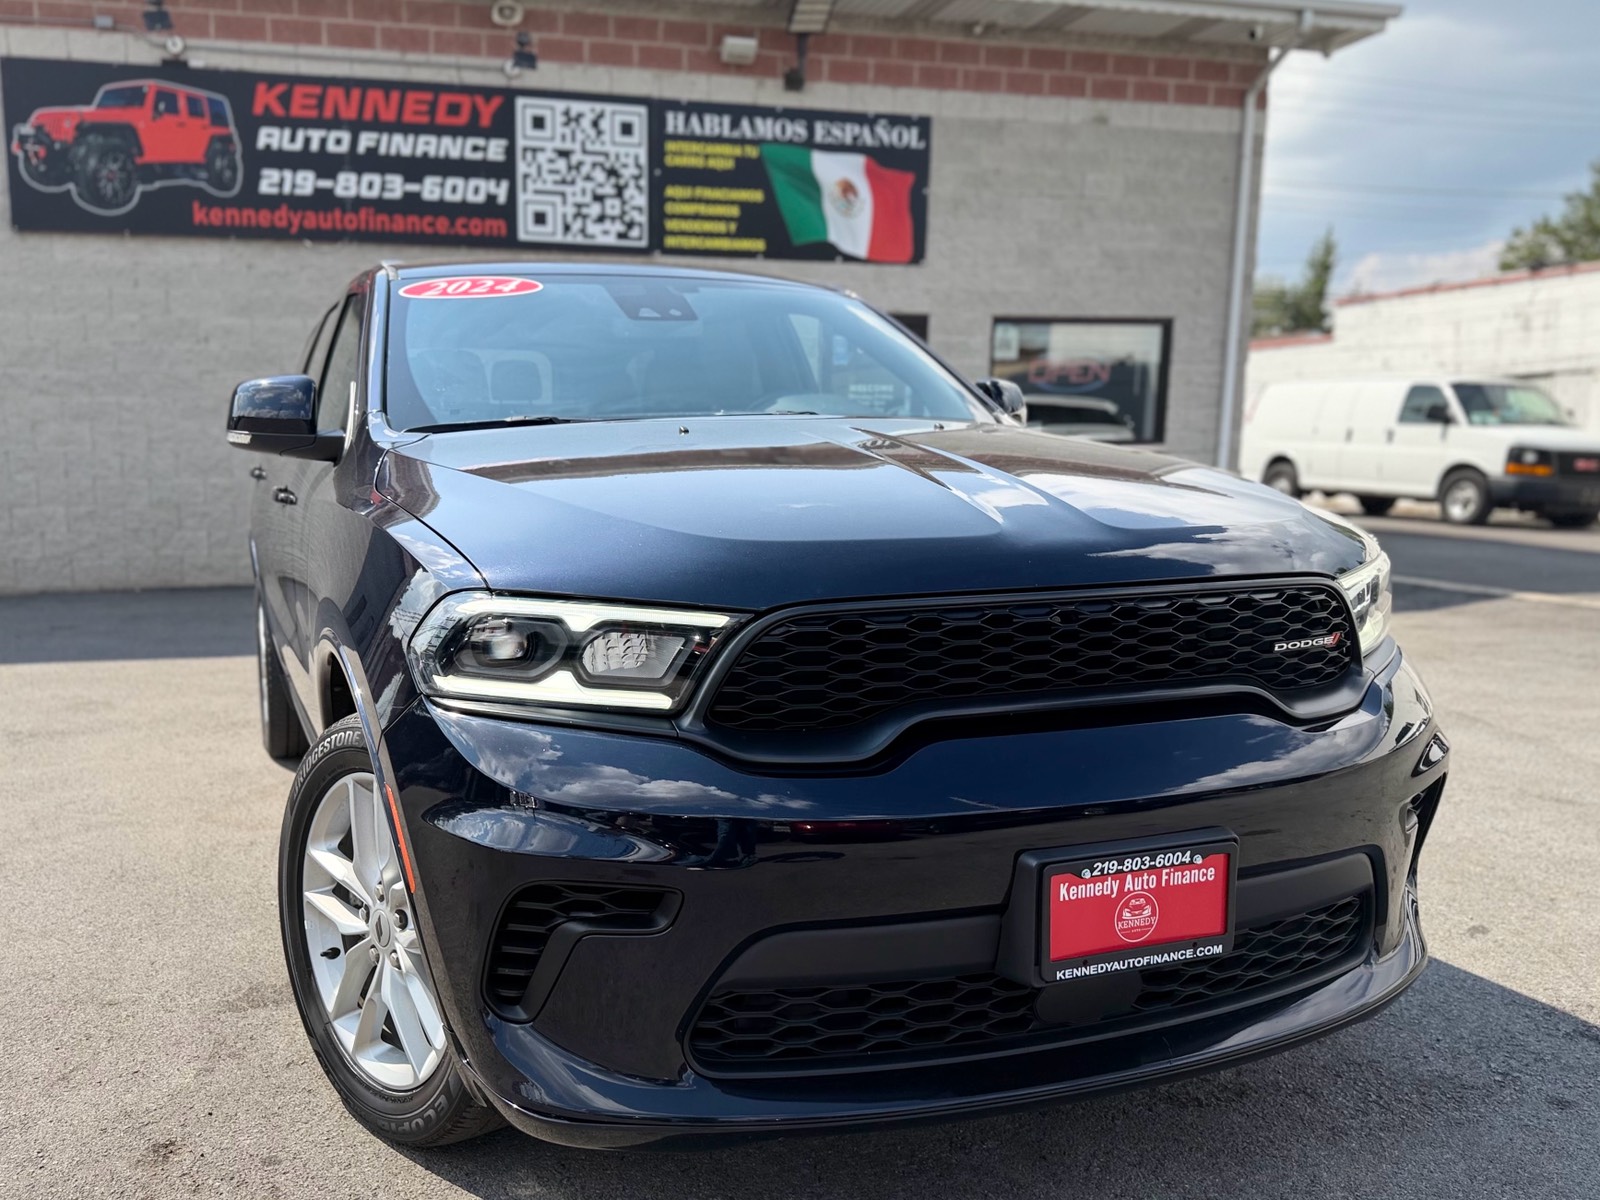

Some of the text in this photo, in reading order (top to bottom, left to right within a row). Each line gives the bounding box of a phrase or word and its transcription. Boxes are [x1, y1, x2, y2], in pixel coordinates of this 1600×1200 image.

[252, 81, 505, 128] KENNEDY
[256, 126, 509, 162] AUTO FINANCE
[664, 110, 926, 150] HABLAMOS ESPAÑOL
[258, 167, 510, 205] 219-803-6004
[192, 201, 508, 236] kennedyautofinance.com
[421, 279, 522, 296] 2024
[1028, 358, 1111, 384] OPEN
[1274, 636, 1335, 651] DODGE
[1092, 850, 1192, 877] 219-803-6004
[1059, 866, 1216, 902] Kennedy Auto Finance
[1117, 916, 1156, 930] KENNEDY
[1056, 944, 1223, 981] KENNEDYAUTOFINANCE.COM
